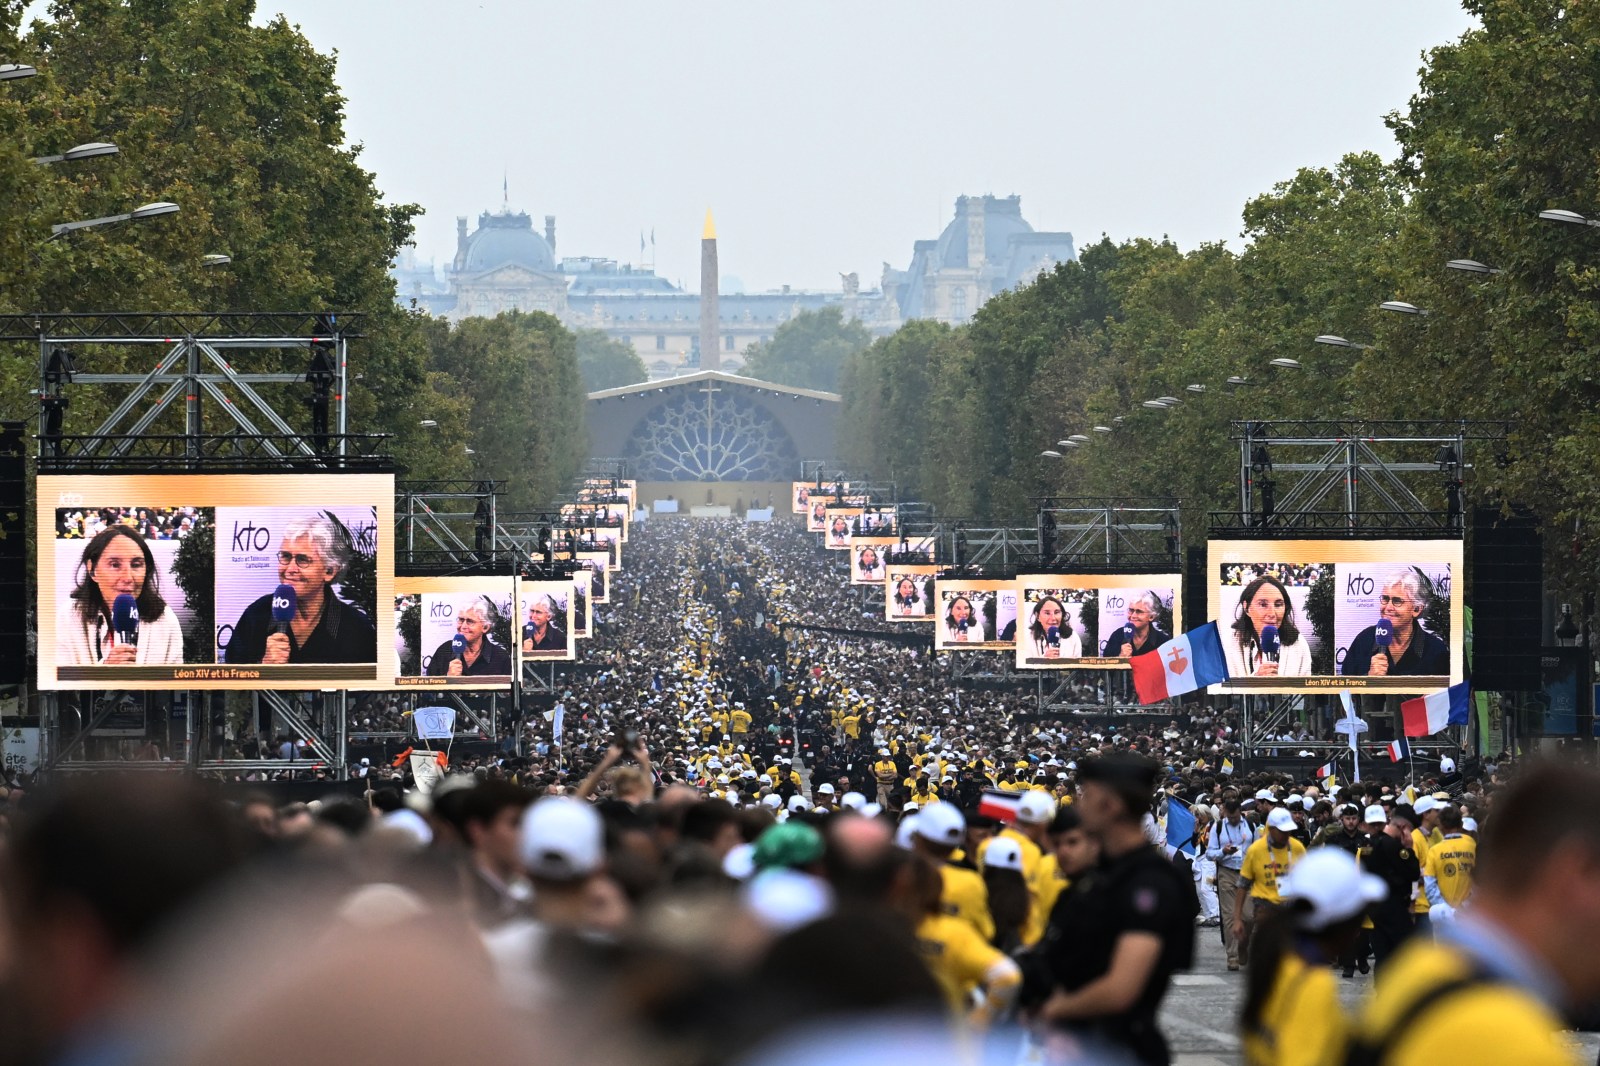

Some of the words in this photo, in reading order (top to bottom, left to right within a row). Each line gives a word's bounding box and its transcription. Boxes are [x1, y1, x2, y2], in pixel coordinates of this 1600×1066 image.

[232, 520, 270, 552] kto
[1347, 572, 1375, 596] kto
[272, 596, 290, 609] kto
[1002, 594, 1017, 605] kto
[1105, 594, 1125, 609] kto
[430, 601, 453, 617] kto
[1375, 627, 1387, 636] kto
[173, 669, 195, 678] Léon
[195, 669, 209, 678] XIV
[211, 669, 221, 678] et
[221, 669, 230, 678] la
[230, 669, 260, 678] France
